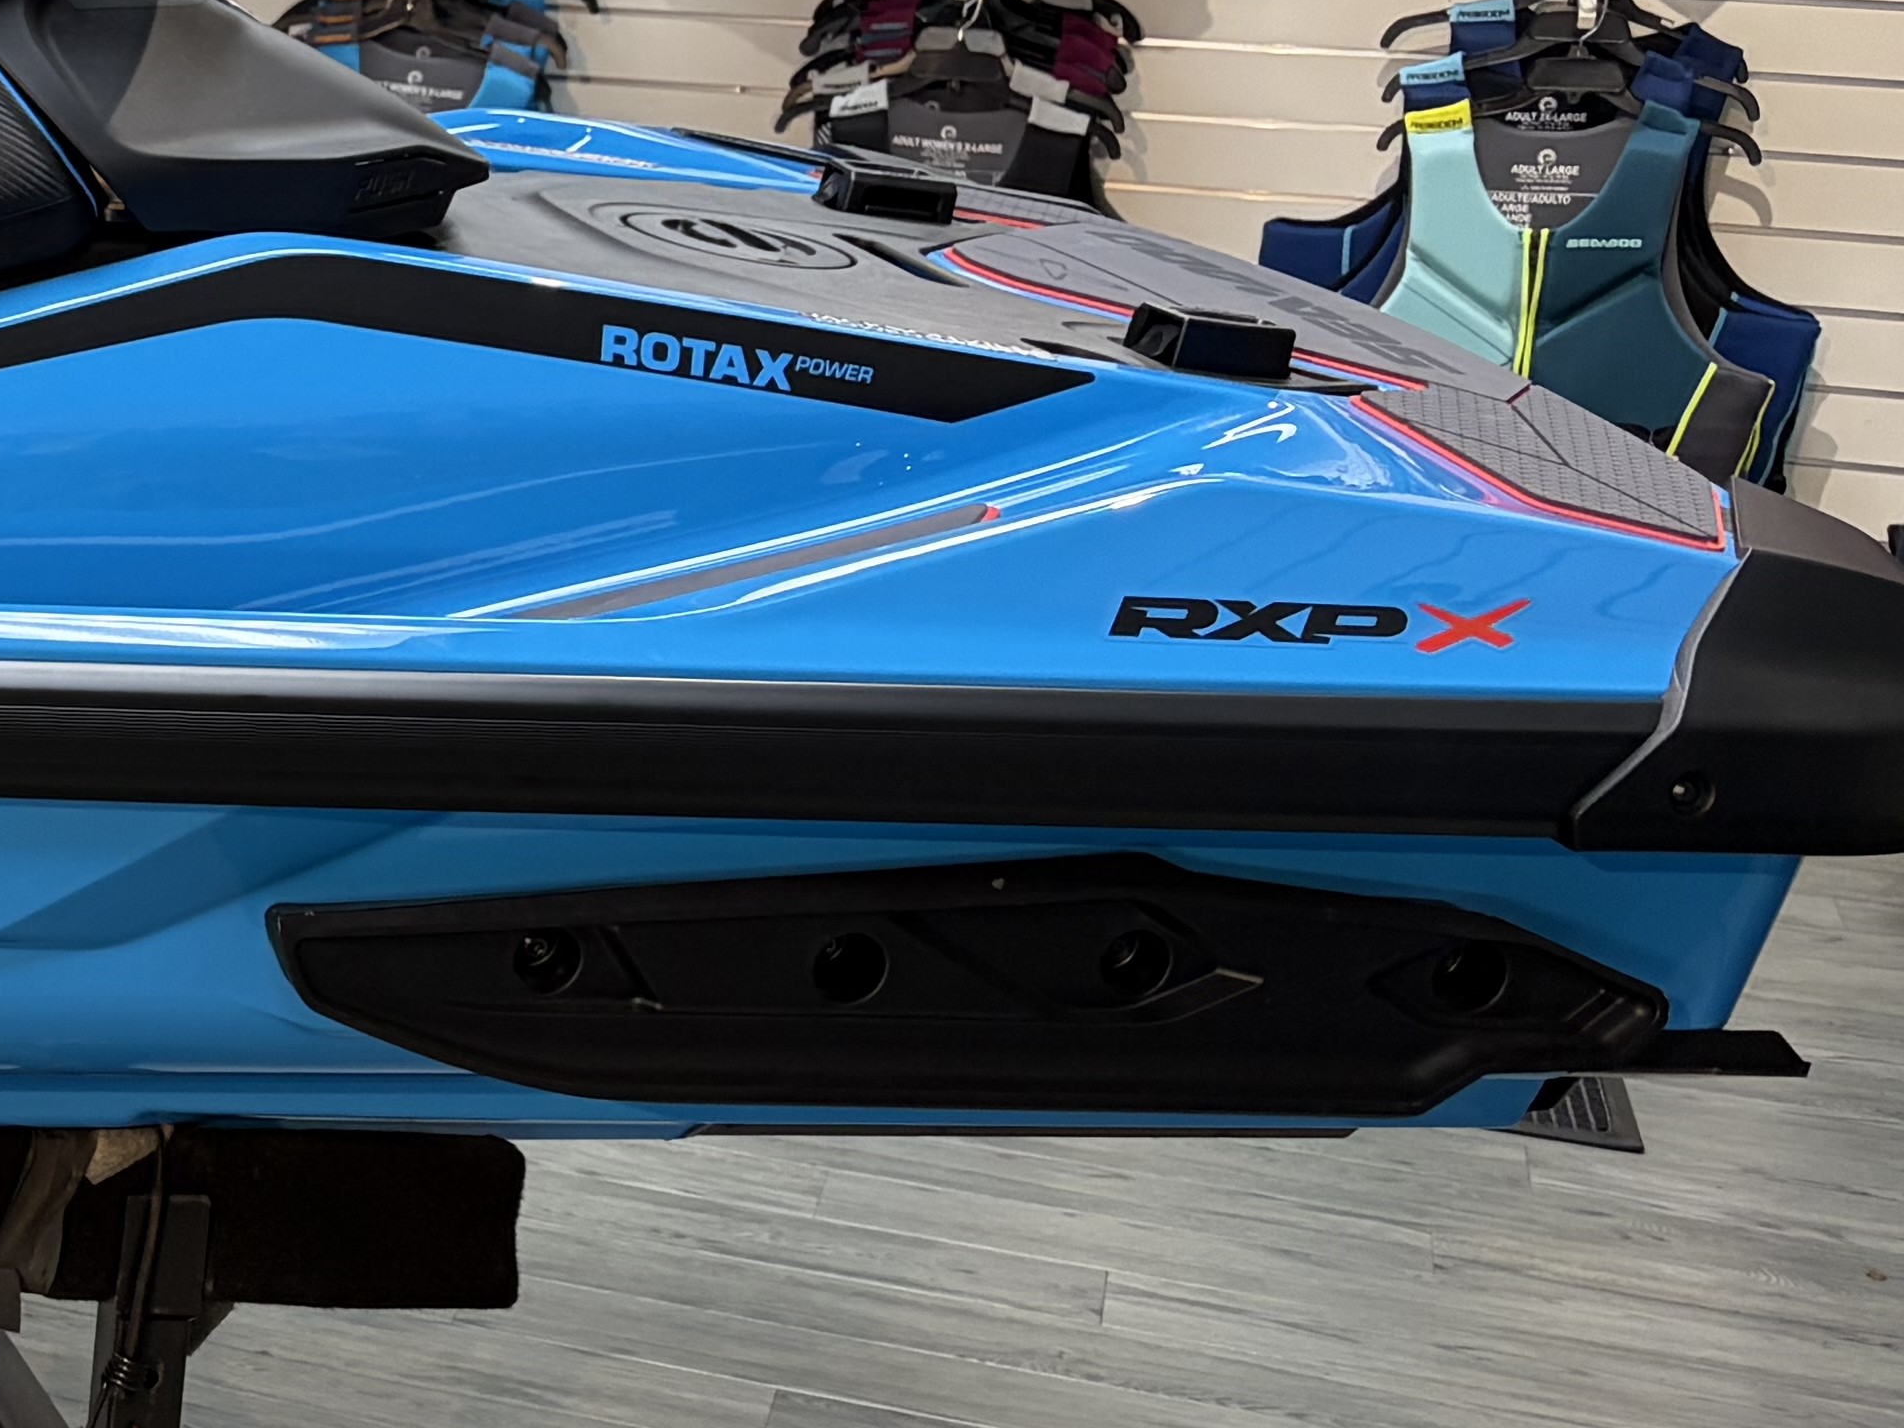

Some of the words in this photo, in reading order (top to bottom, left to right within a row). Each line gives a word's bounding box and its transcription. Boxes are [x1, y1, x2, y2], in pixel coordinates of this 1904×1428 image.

[1505, 111, 1538, 123] ADULT
[1510, 164, 1544, 175] ADULT
[1545, 164, 1580, 176] LARGE
[600, 324, 794, 391] ROTAX
[795, 355, 874, 384] POWER
